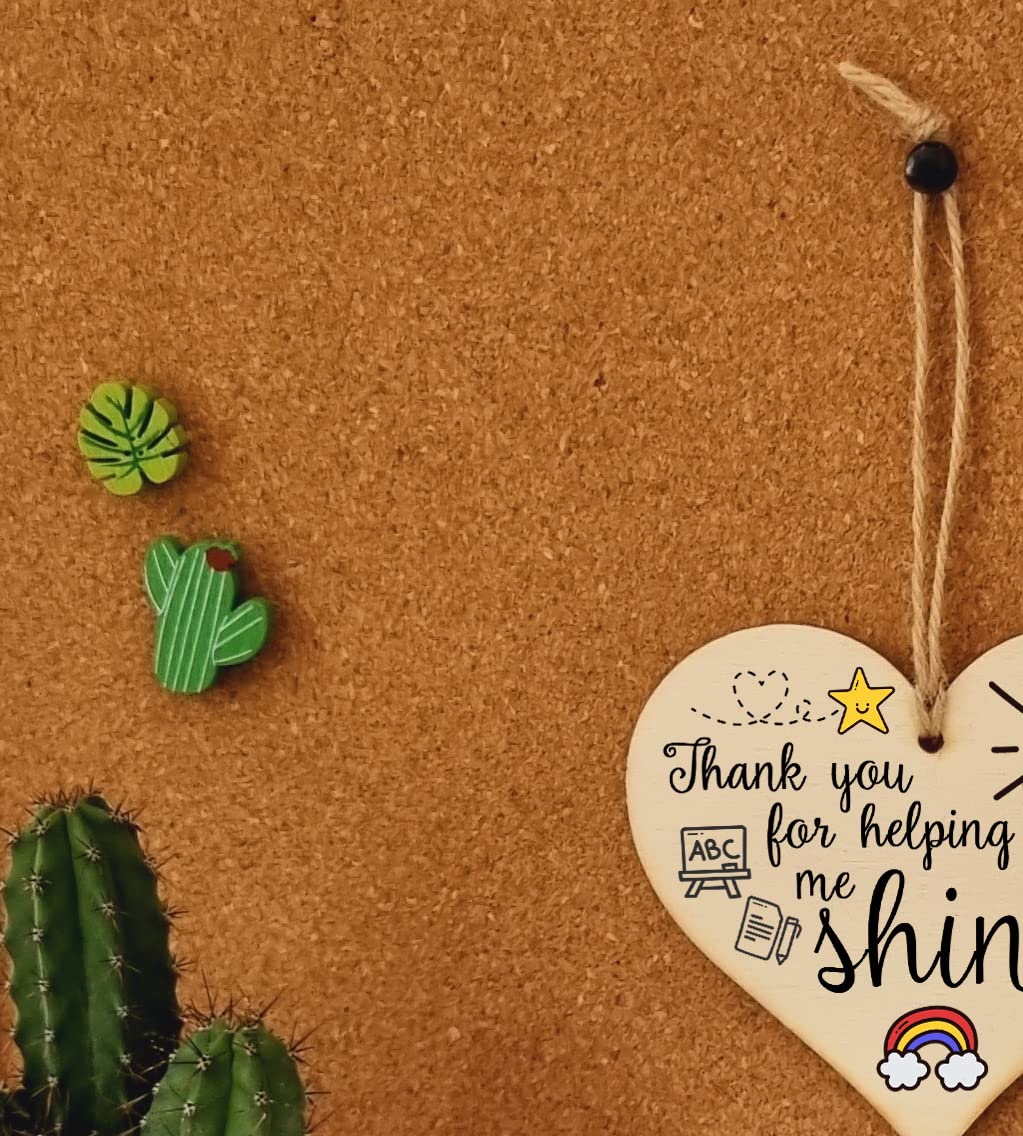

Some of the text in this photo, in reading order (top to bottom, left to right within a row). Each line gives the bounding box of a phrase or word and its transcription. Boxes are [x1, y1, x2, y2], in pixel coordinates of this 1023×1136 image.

[663, 737, 913, 813] Thank you
[688, 837, 742, 861] ABC
[767, 801, 1015, 870] for helping
[796, 868, 855, 901] me
